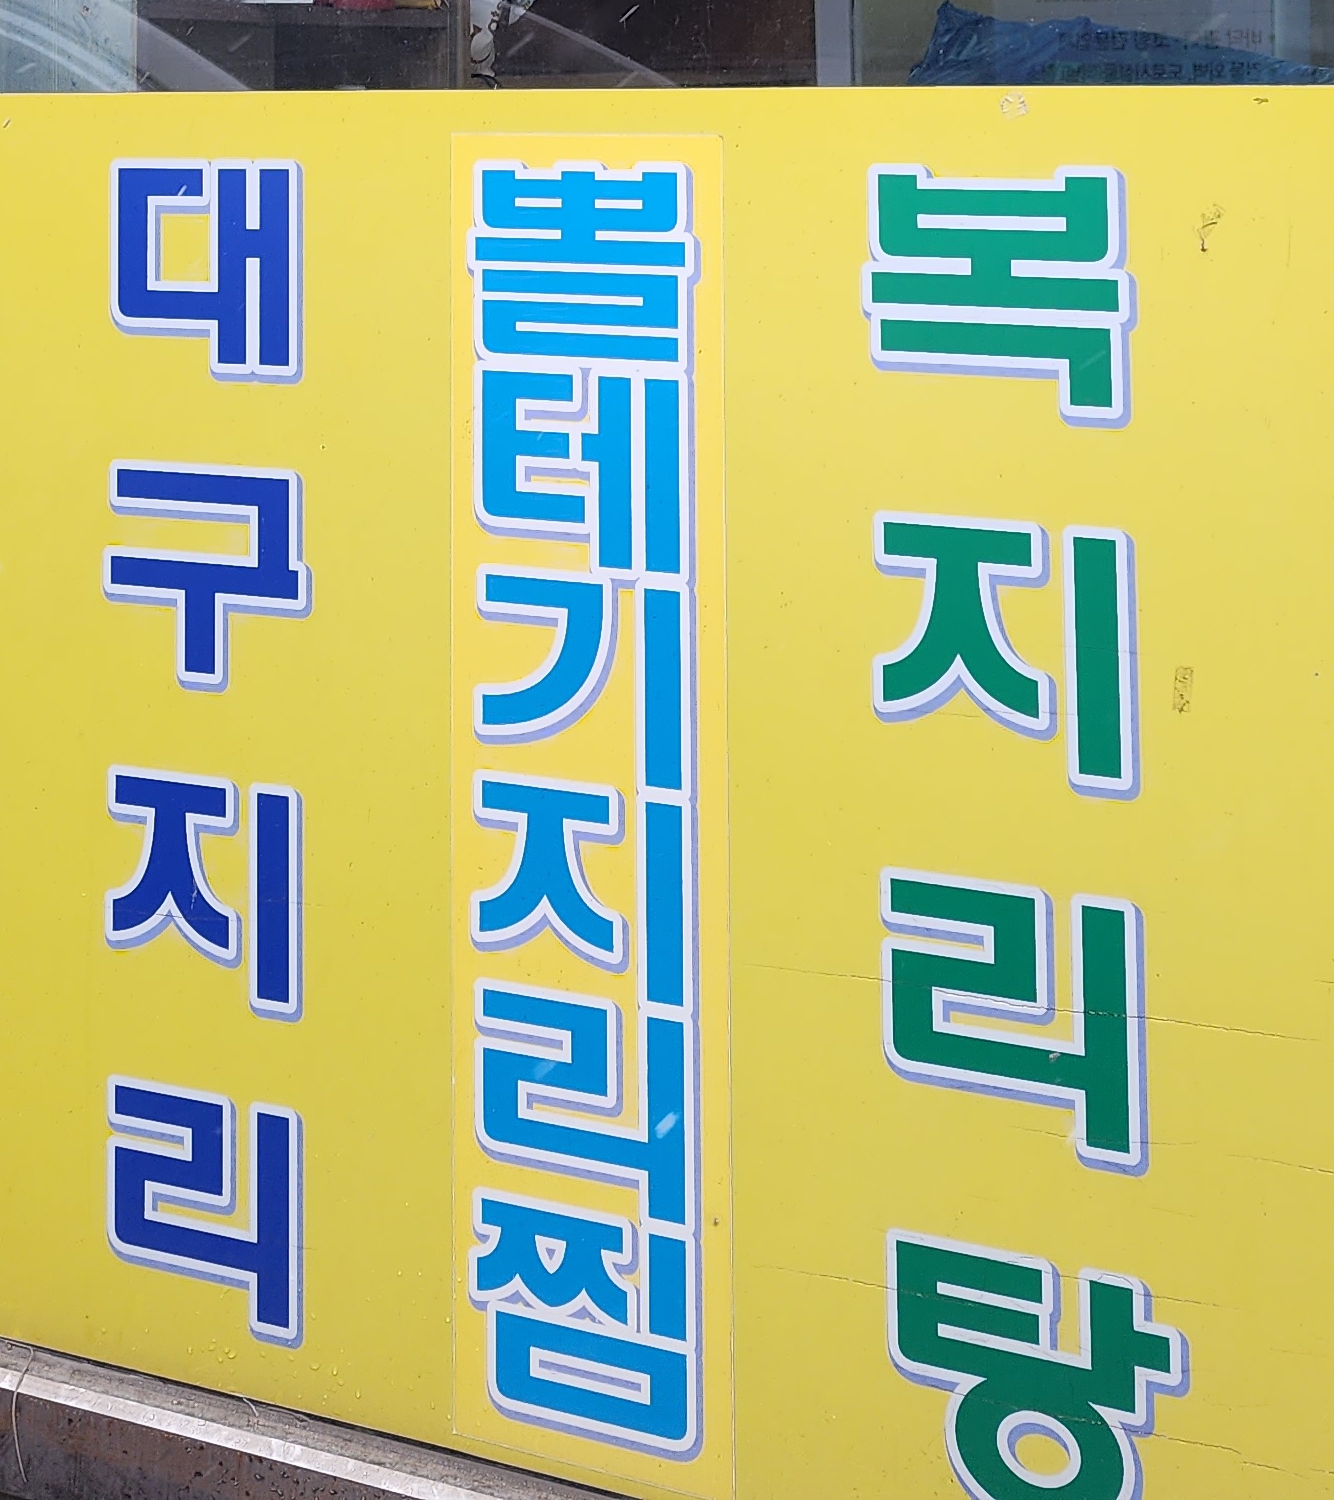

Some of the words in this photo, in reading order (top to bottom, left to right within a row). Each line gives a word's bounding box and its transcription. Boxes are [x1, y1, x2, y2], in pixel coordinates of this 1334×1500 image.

[106, 162, 305, 1338] 대구지리
[470, 164, 699, 1448] 뽈테기지리찜
[866, 165, 1181, 1500] 복지리탕
